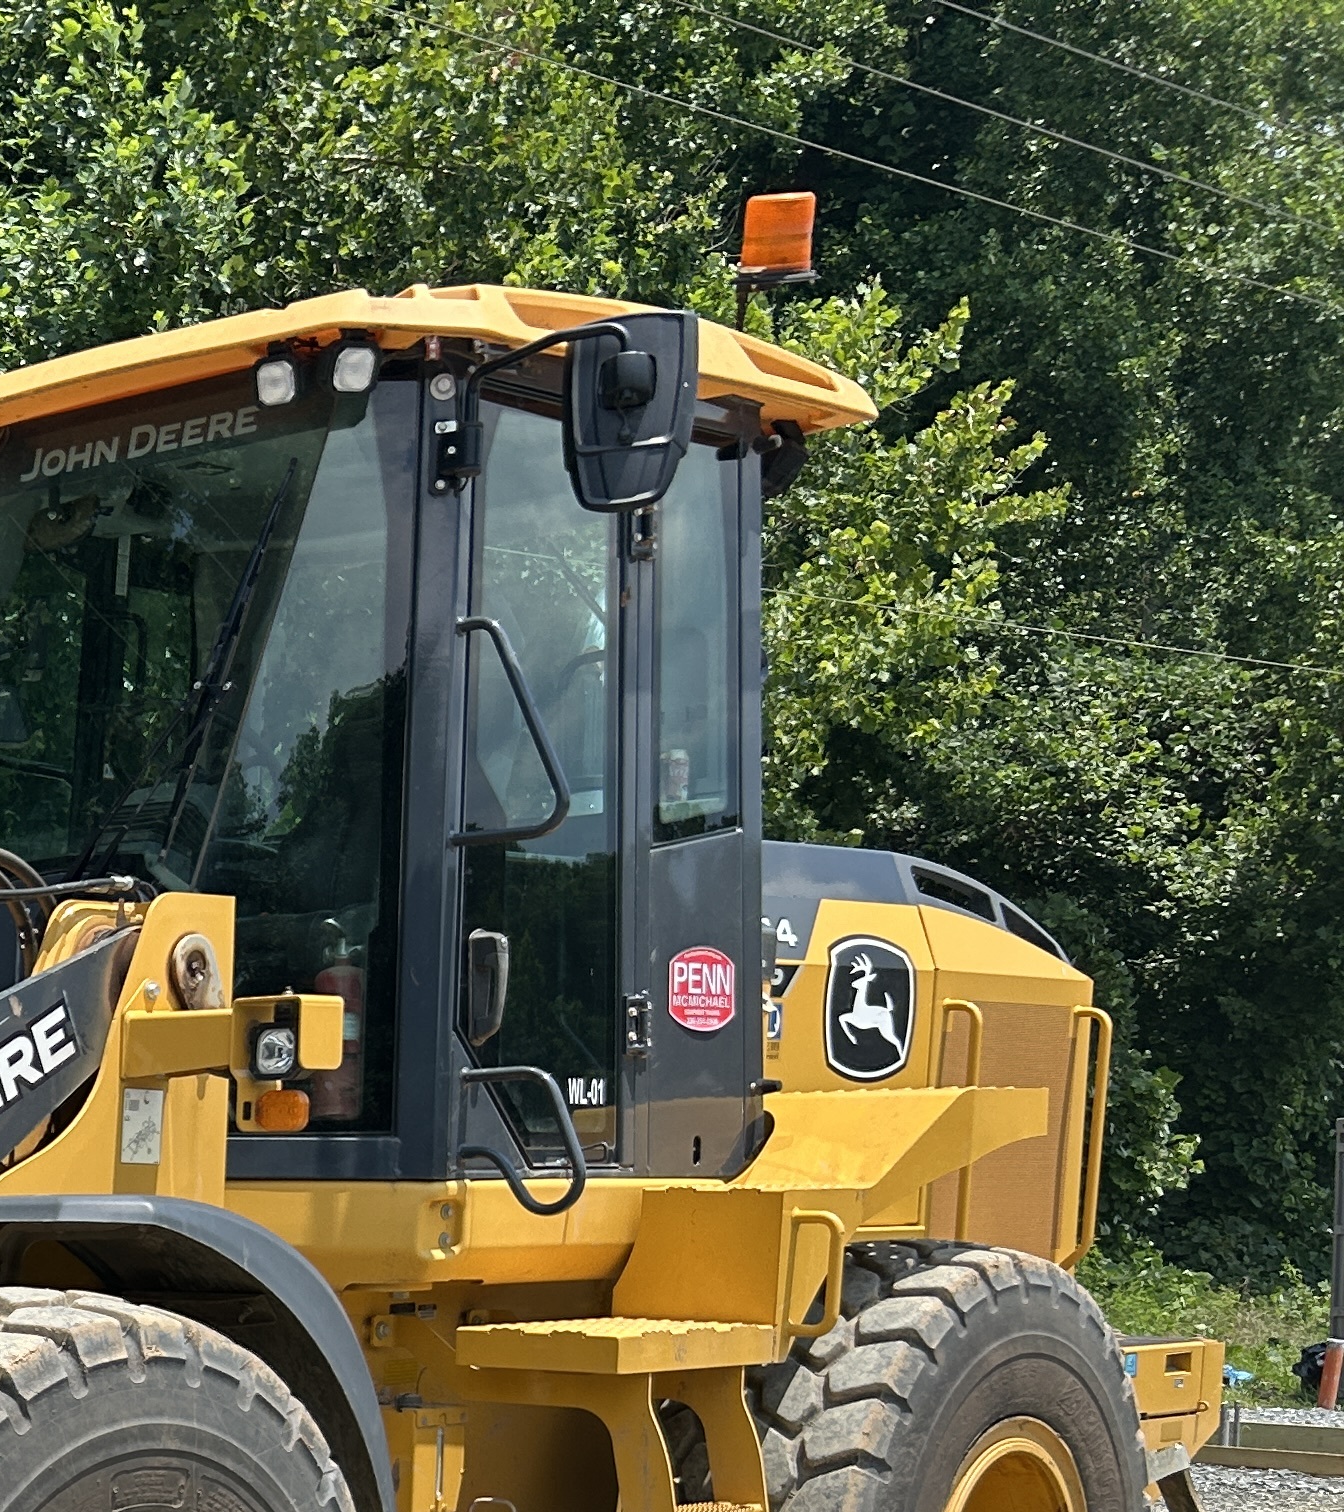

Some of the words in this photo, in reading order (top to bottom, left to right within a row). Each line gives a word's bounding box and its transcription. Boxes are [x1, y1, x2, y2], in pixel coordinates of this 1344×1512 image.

[20, 435, 119, 483] JOHN
[126, 406, 259, 460] DEERE
[673, 962, 731, 995] PENN
[567, 1077, 604, 1105] WL-01
